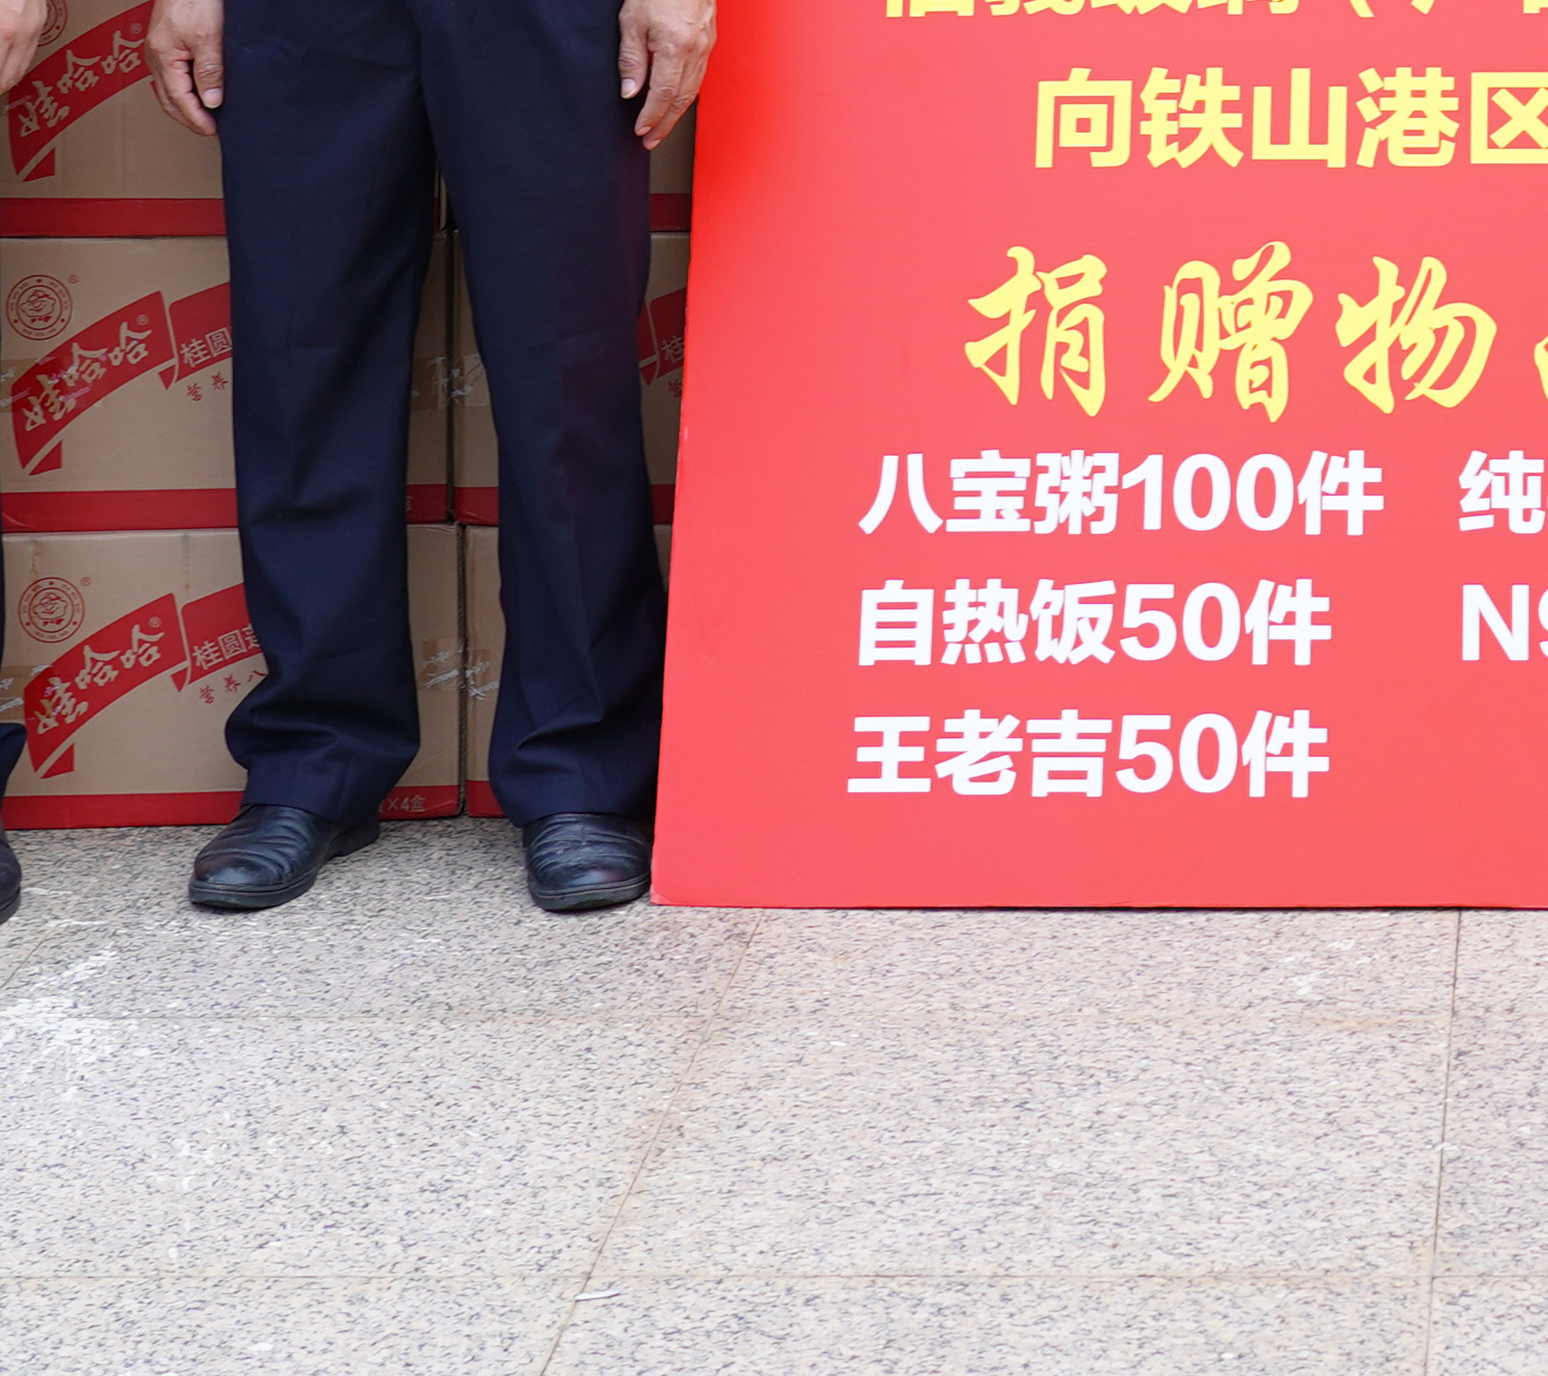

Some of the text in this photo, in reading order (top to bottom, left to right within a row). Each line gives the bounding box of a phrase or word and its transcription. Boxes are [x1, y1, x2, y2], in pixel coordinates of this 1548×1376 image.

[19, 30, 146, 138] 娃哈哈
[22, 322, 153, 432] 娃哈哈
[858, 449, 1385, 540] 八宝粥100件
[854, 578, 1334, 669] 自热饭50件
[35, 624, 165, 735] 娃哈哈
[846, 710, 1331, 801] 王老吉50件
